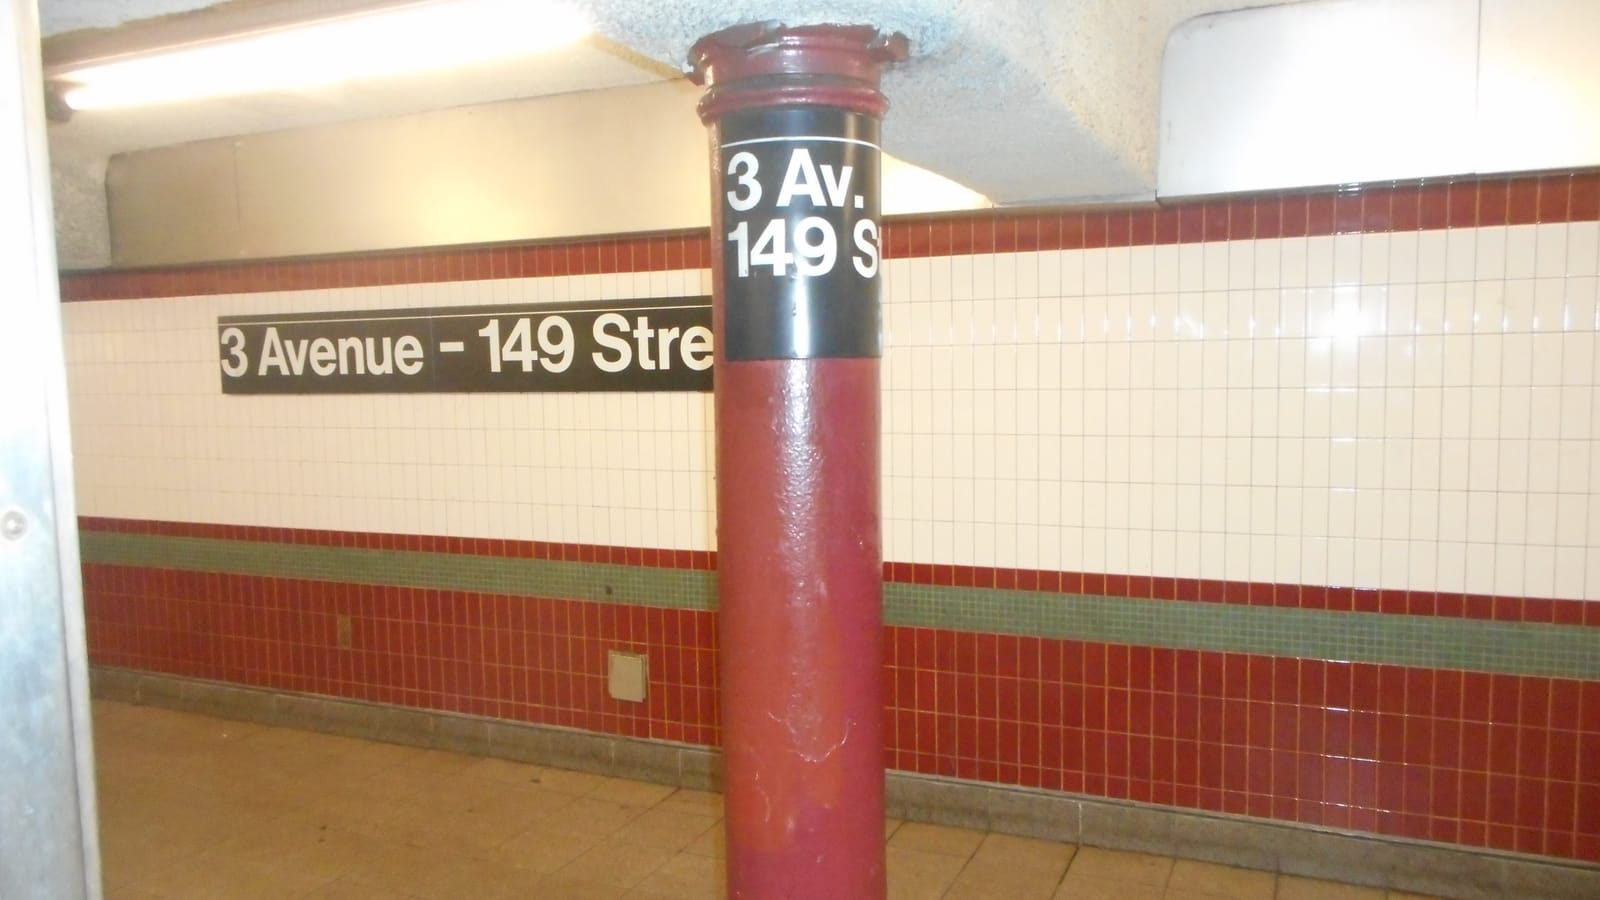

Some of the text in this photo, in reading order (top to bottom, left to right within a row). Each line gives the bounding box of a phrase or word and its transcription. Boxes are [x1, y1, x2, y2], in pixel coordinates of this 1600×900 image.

[727, 148, 864, 212] 3 Av.
[728, 216, 882, 278] 149 S
[220, 327, 249, 378] 3
[258, 327, 424, 377] Avenue
[478, 315, 575, 374] 149
[592, 313, 714, 373] Stre
